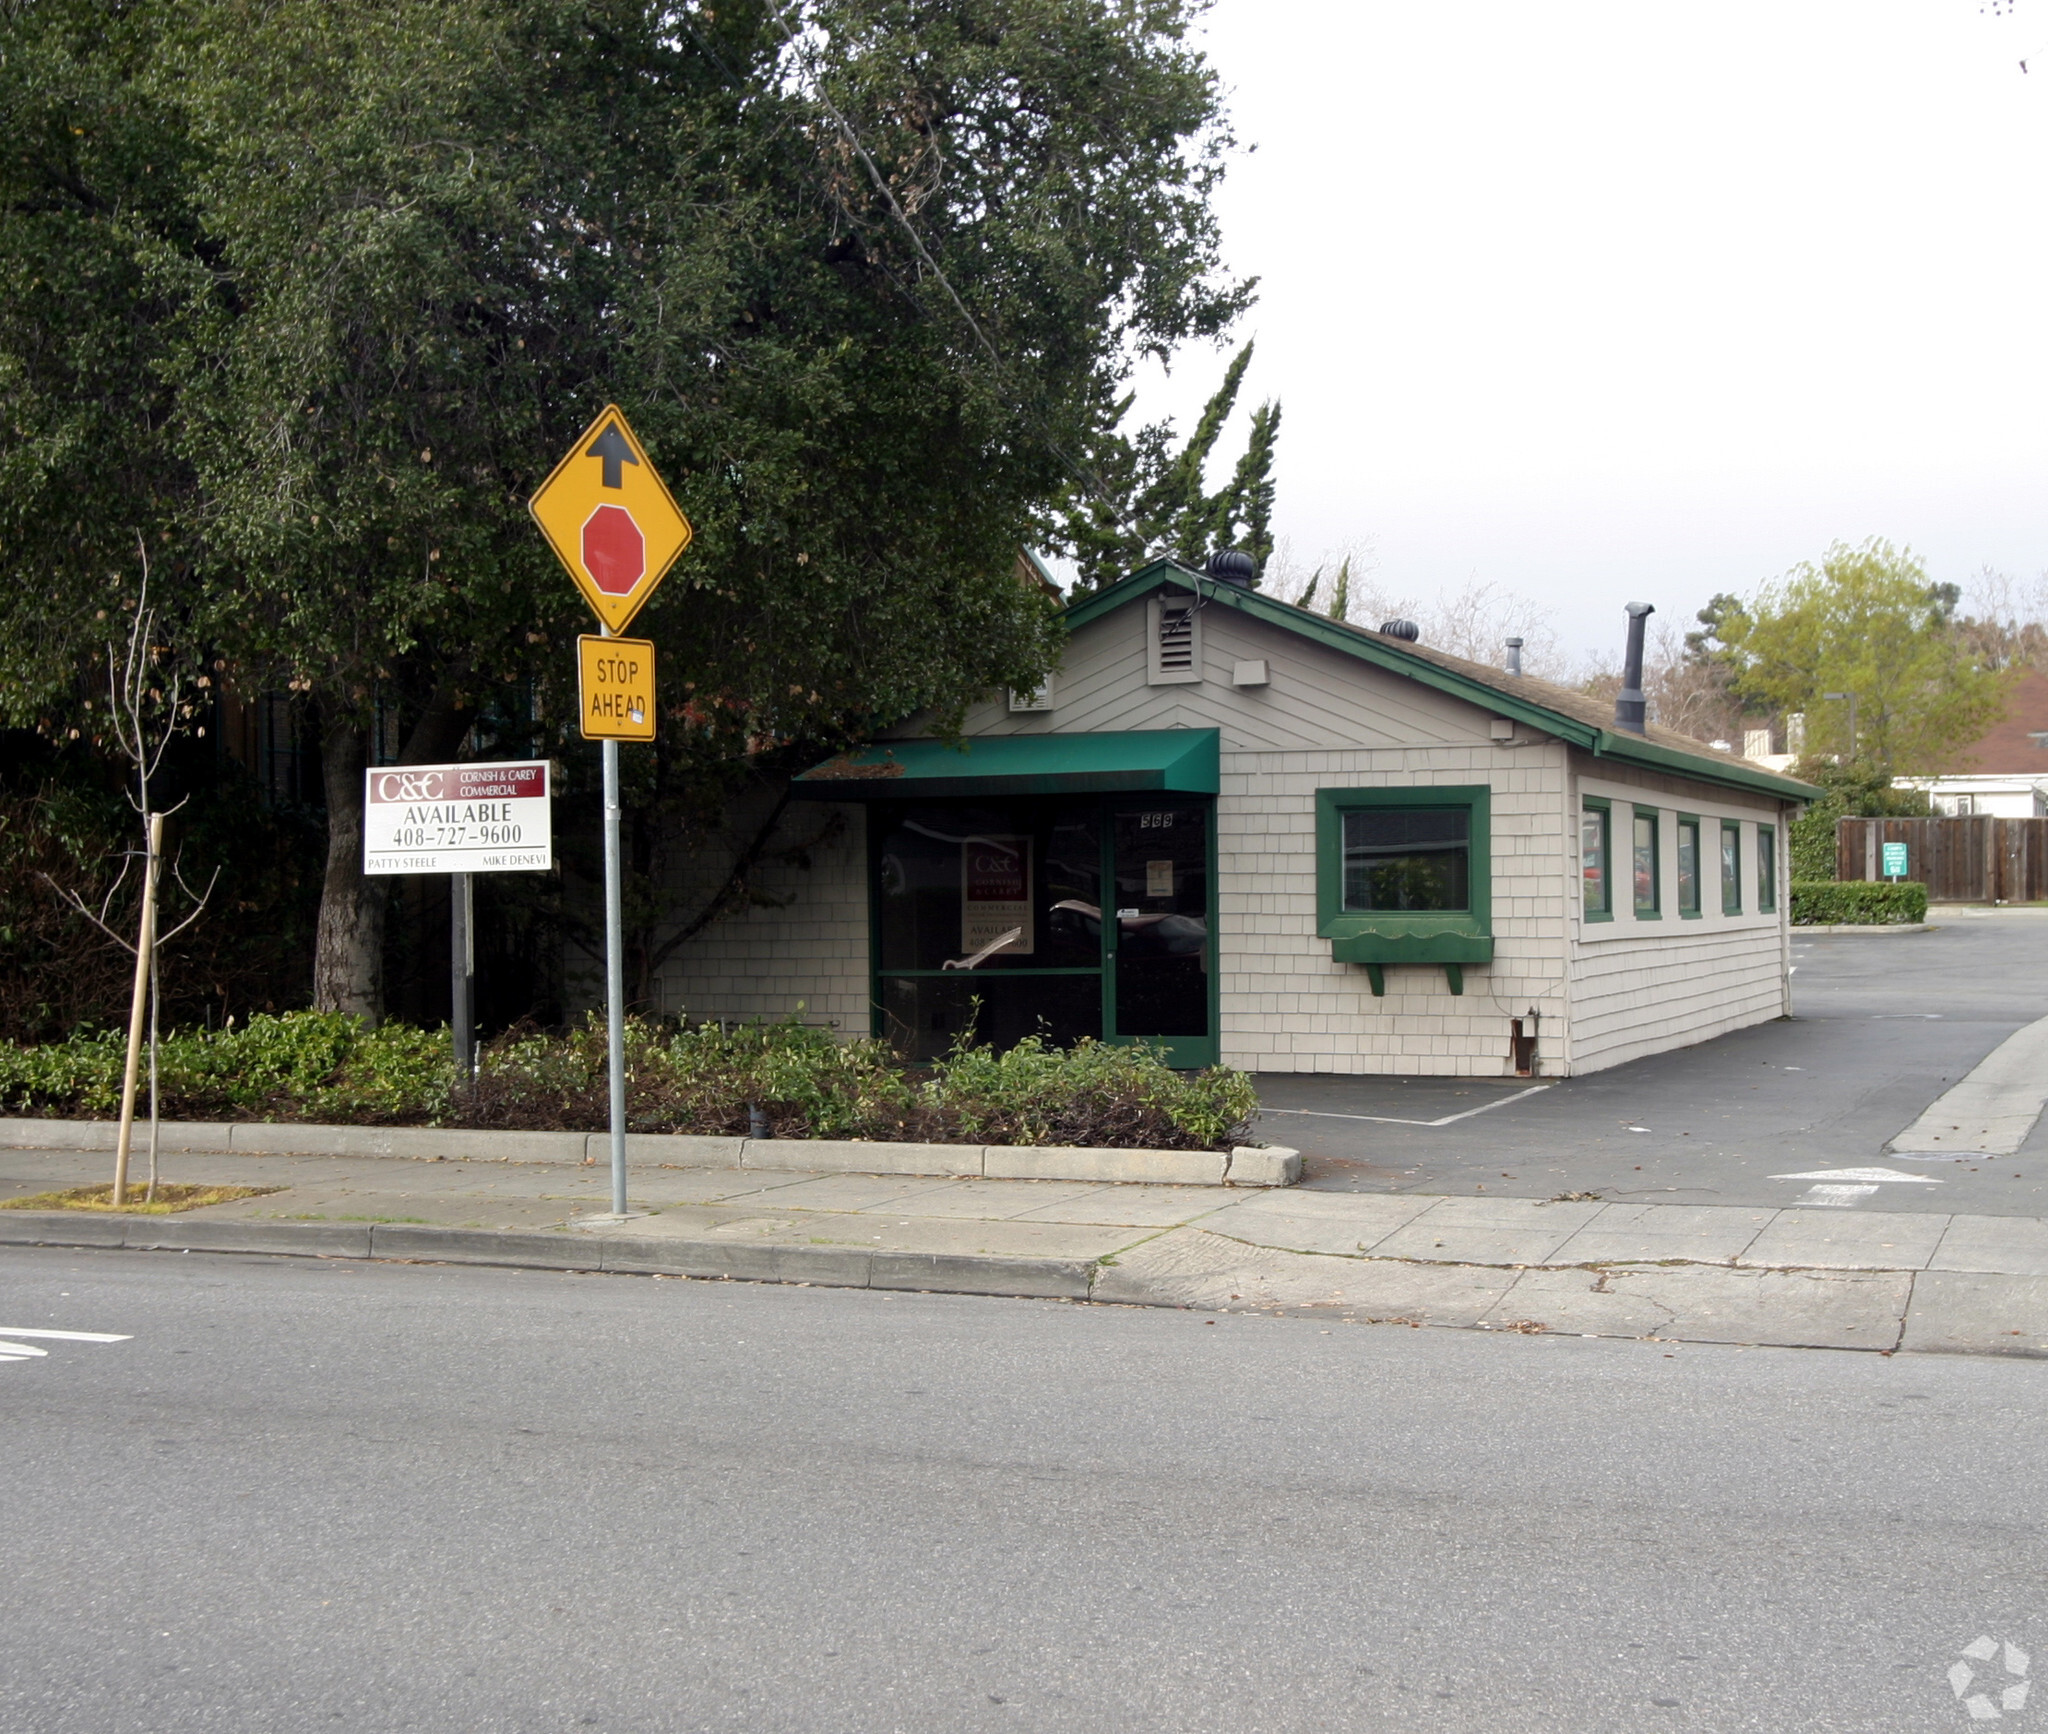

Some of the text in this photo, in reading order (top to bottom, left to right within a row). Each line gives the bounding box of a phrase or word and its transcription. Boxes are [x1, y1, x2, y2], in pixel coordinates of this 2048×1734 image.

[597, 659, 638, 684] STOP
[591, 693, 646, 718] AHEAD
[460, 769, 537, 782] CORNISH & CAREY
[378, 772, 444, 802] C&C
[459, 785, 517, 797] COMMERCIAL
[403, 803, 512, 825] AVAILABLE
[1142, 814, 1172, 827] 569
[393, 824, 522, 847] 408-727-9600
[368, 857, 437, 869] PATTY STEELE
[482, 854, 546, 866] MIKE DENEVI
